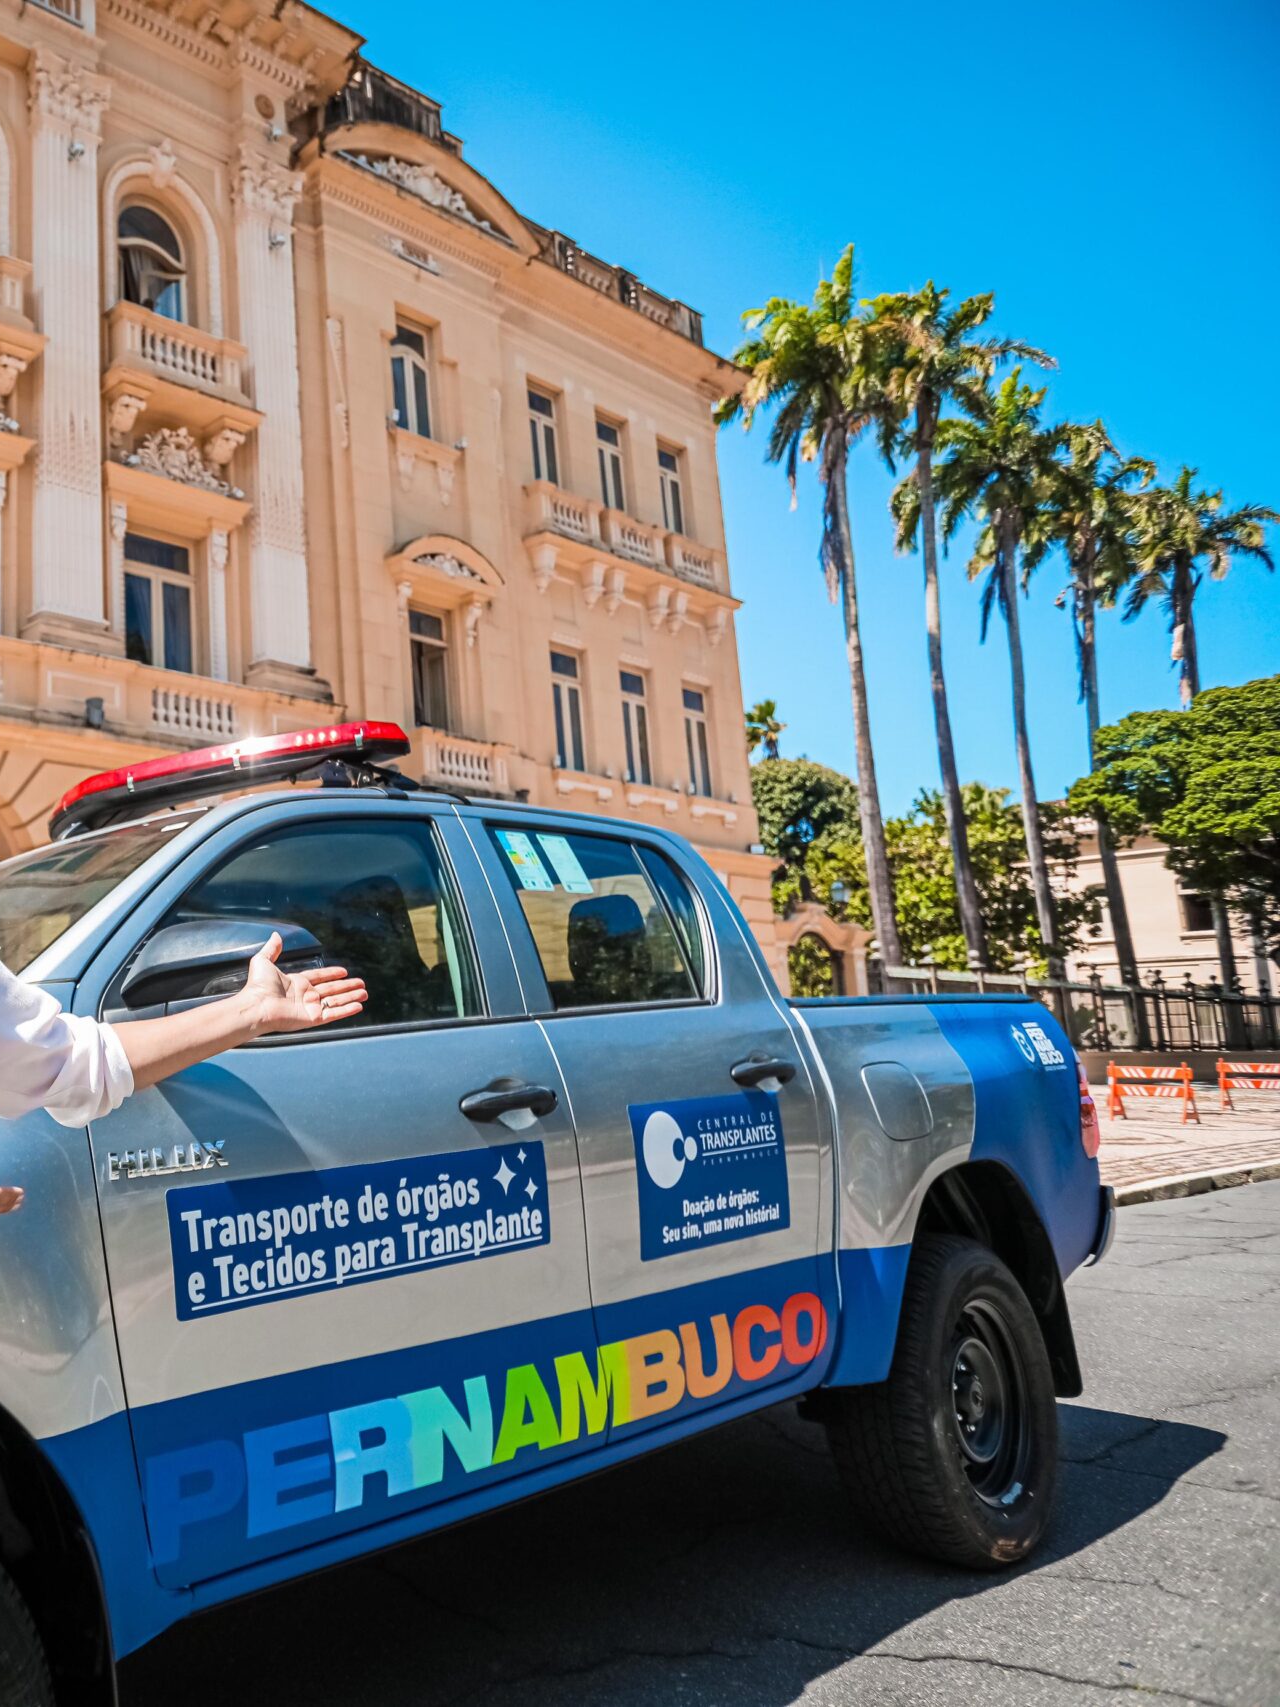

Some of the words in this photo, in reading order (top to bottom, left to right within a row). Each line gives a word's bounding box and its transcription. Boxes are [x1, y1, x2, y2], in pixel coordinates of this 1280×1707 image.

[697, 1114, 753, 1131] CENTRAL
[760, 1110, 775, 1123] DE
[699, 1124, 777, 1151] TRANSPLANTES
[107, 1140, 229, 1180] HILUX
[180, 1195, 350, 1253] Transporte
[357, 1185, 389, 1224] de
[396, 1173, 480, 1222] órgãos
[682, 1195, 715, 1218] Doação
[716, 1193, 727, 1210] de
[728, 1188, 760, 1210] órgãos:
[662, 1225, 680, 1244] Seu
[682, 1221, 702, 1239] sim,
[703, 1219, 722, 1235] uma
[723, 1214, 744, 1231] nova
[187, 1271, 206, 1304] e
[213, 1244, 327, 1298] Tecidos
[335, 1236, 396, 1285] para
[402, 1206, 543, 1256] Transplante
[145, 1291, 828, 1569] PERNAMBUCO
